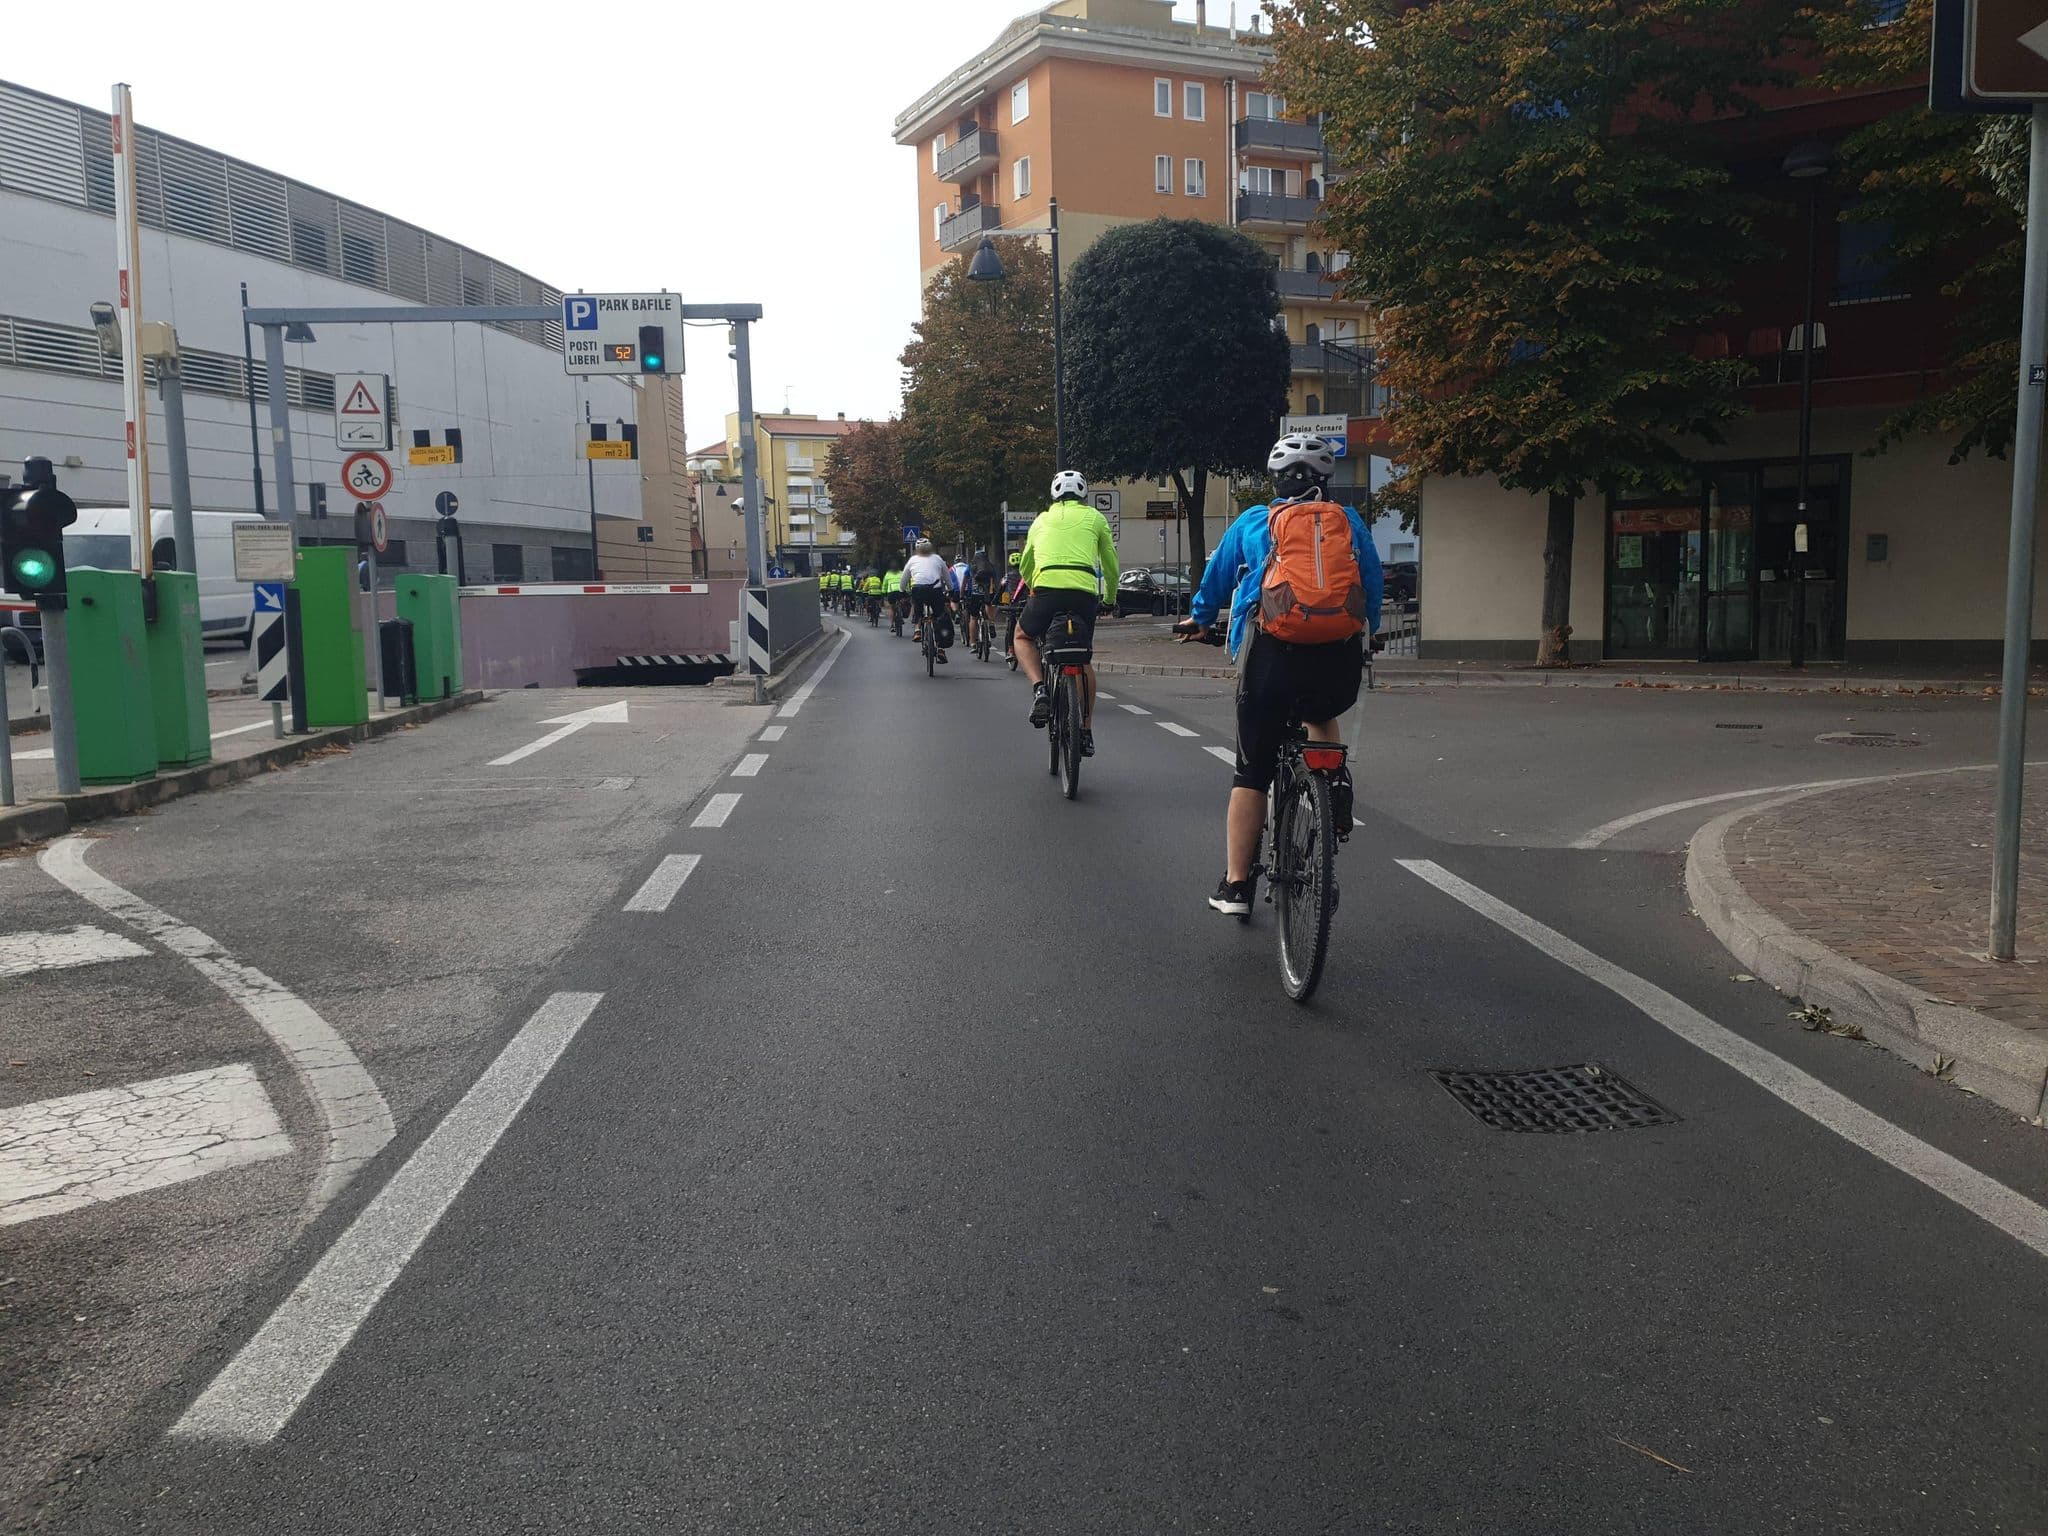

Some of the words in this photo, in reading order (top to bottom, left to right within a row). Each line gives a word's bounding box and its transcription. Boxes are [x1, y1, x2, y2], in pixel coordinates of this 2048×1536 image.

[599, 299, 629, 311] PARK
[632, 299, 672, 311] BAFILE
[571, 301, 591, 328] P
[569, 341, 597, 351] POSTI
[615, 346, 631, 359] 52
[569, 355, 600, 366] LIBERI
